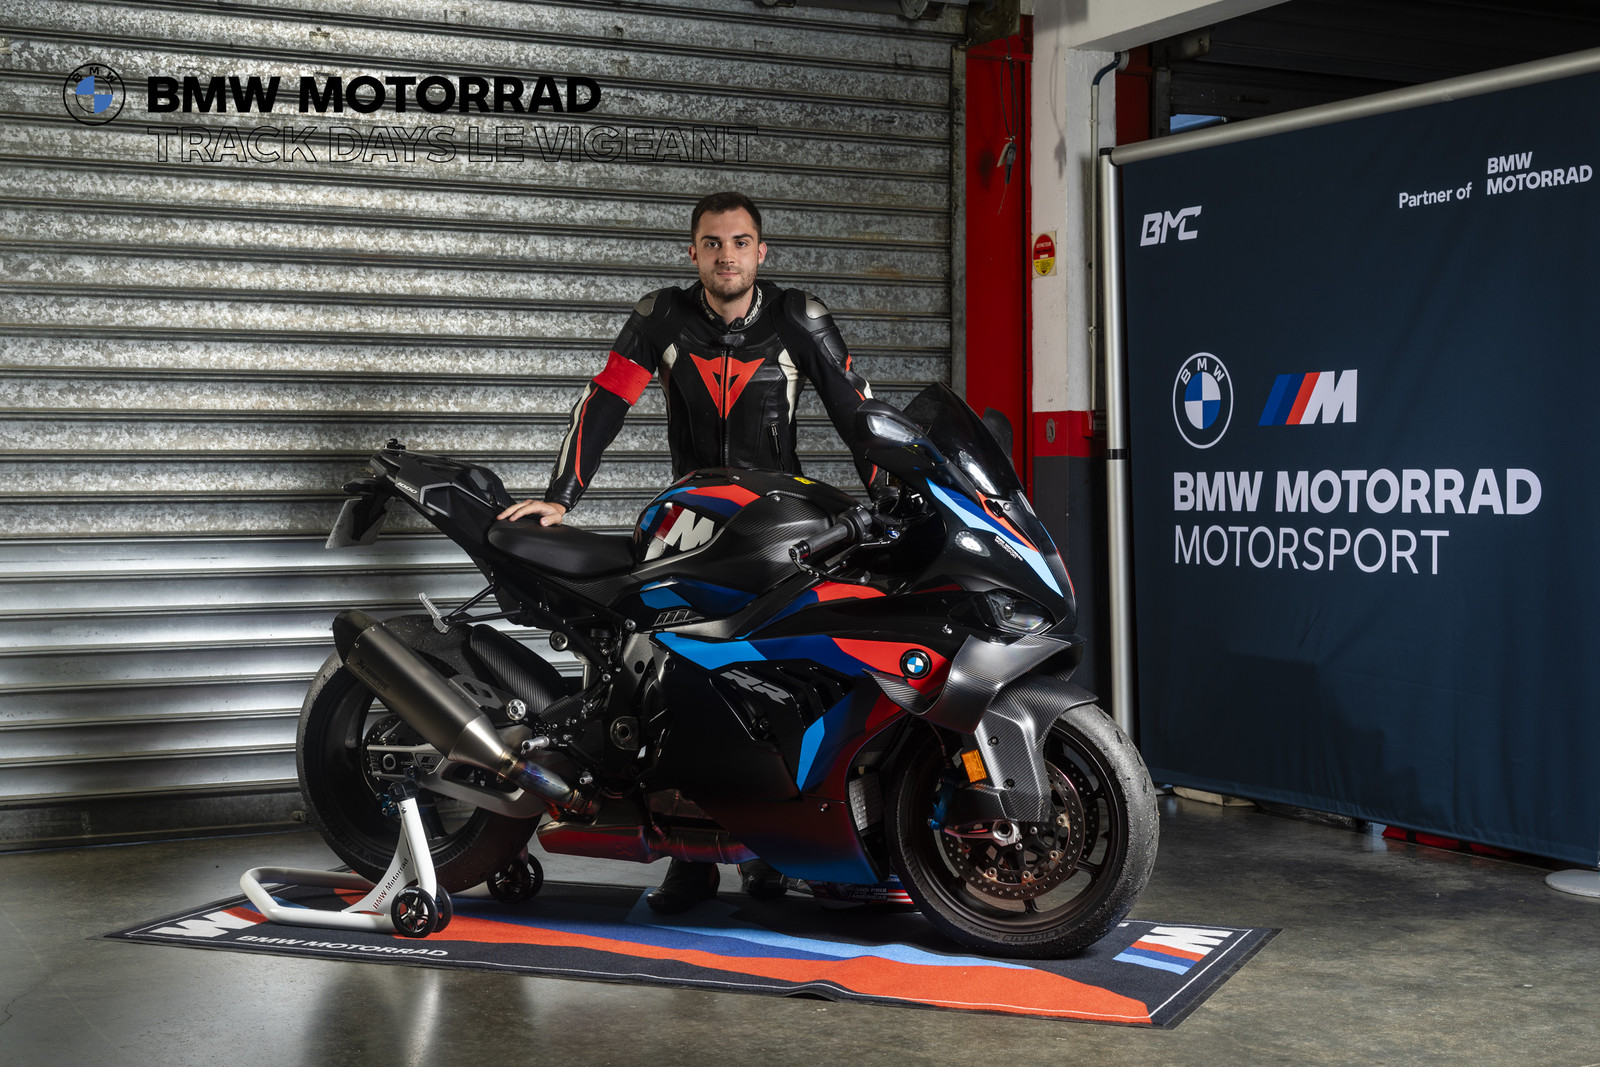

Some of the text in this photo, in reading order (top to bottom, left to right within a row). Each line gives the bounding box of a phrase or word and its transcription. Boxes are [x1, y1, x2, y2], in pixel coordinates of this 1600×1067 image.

[1487, 151, 1533, 174] BMW
[1399, 182, 1473, 208] Partner of
[1486, 164, 1593, 195] MOTORRAD
[1140, 206, 1202, 247] BMC
[1180, 358, 1226, 385] BMW
[1174, 469, 1542, 515] BMW MOTORRAD
[1174, 525, 1450, 575] MOTORSPORT
[720, 669, 791, 705] RR
[385, 857, 409, 891] Motorrad
[235, 935, 449, 957] BMW MOTORRAD
